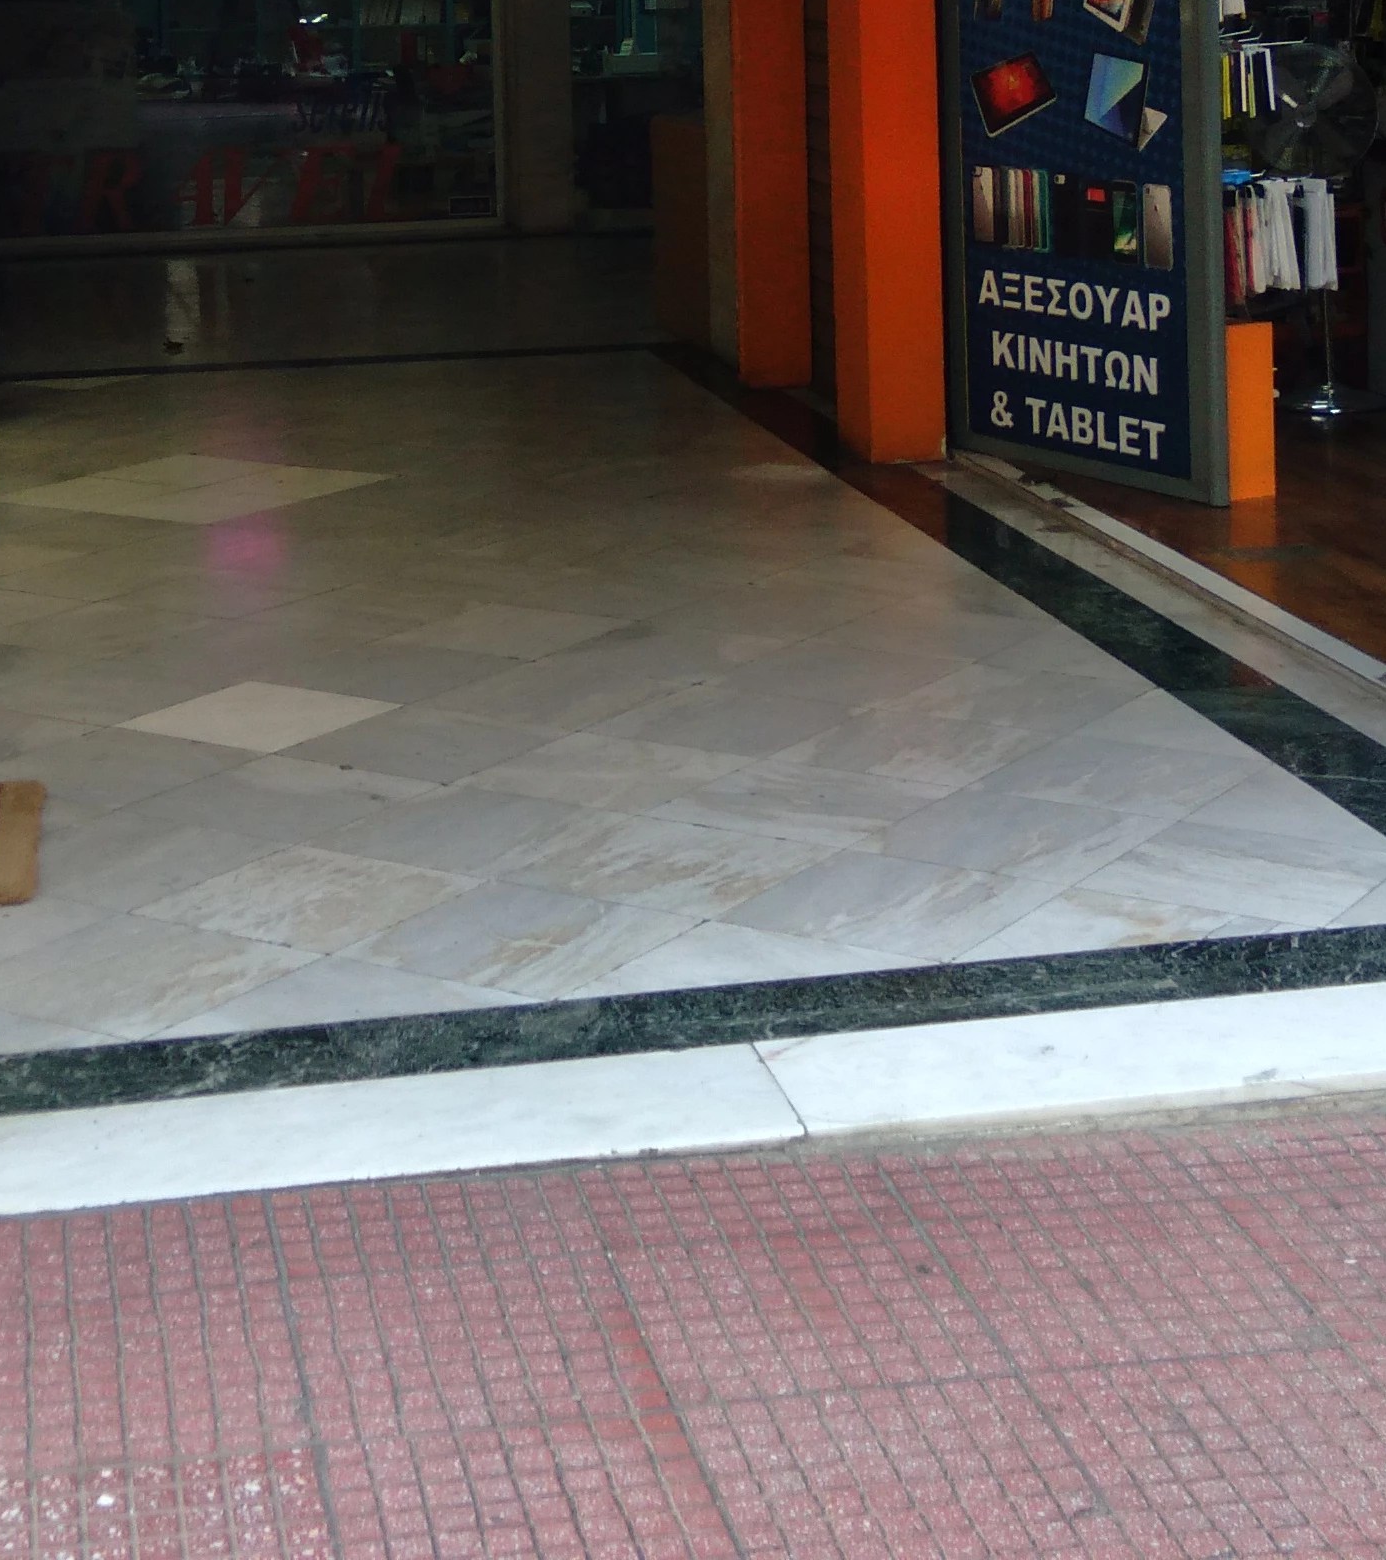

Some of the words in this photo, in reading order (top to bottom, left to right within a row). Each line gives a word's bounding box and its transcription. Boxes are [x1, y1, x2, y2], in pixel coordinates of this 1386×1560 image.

[978, 269, 1171, 332] ΑΞΕΣΟΥΑΡ
[991, 330, 1159, 397] ΚΙΝΗΤΩΝ
[990, 390, 1014, 429] &
[1024, 396, 1166, 462] TABLET
